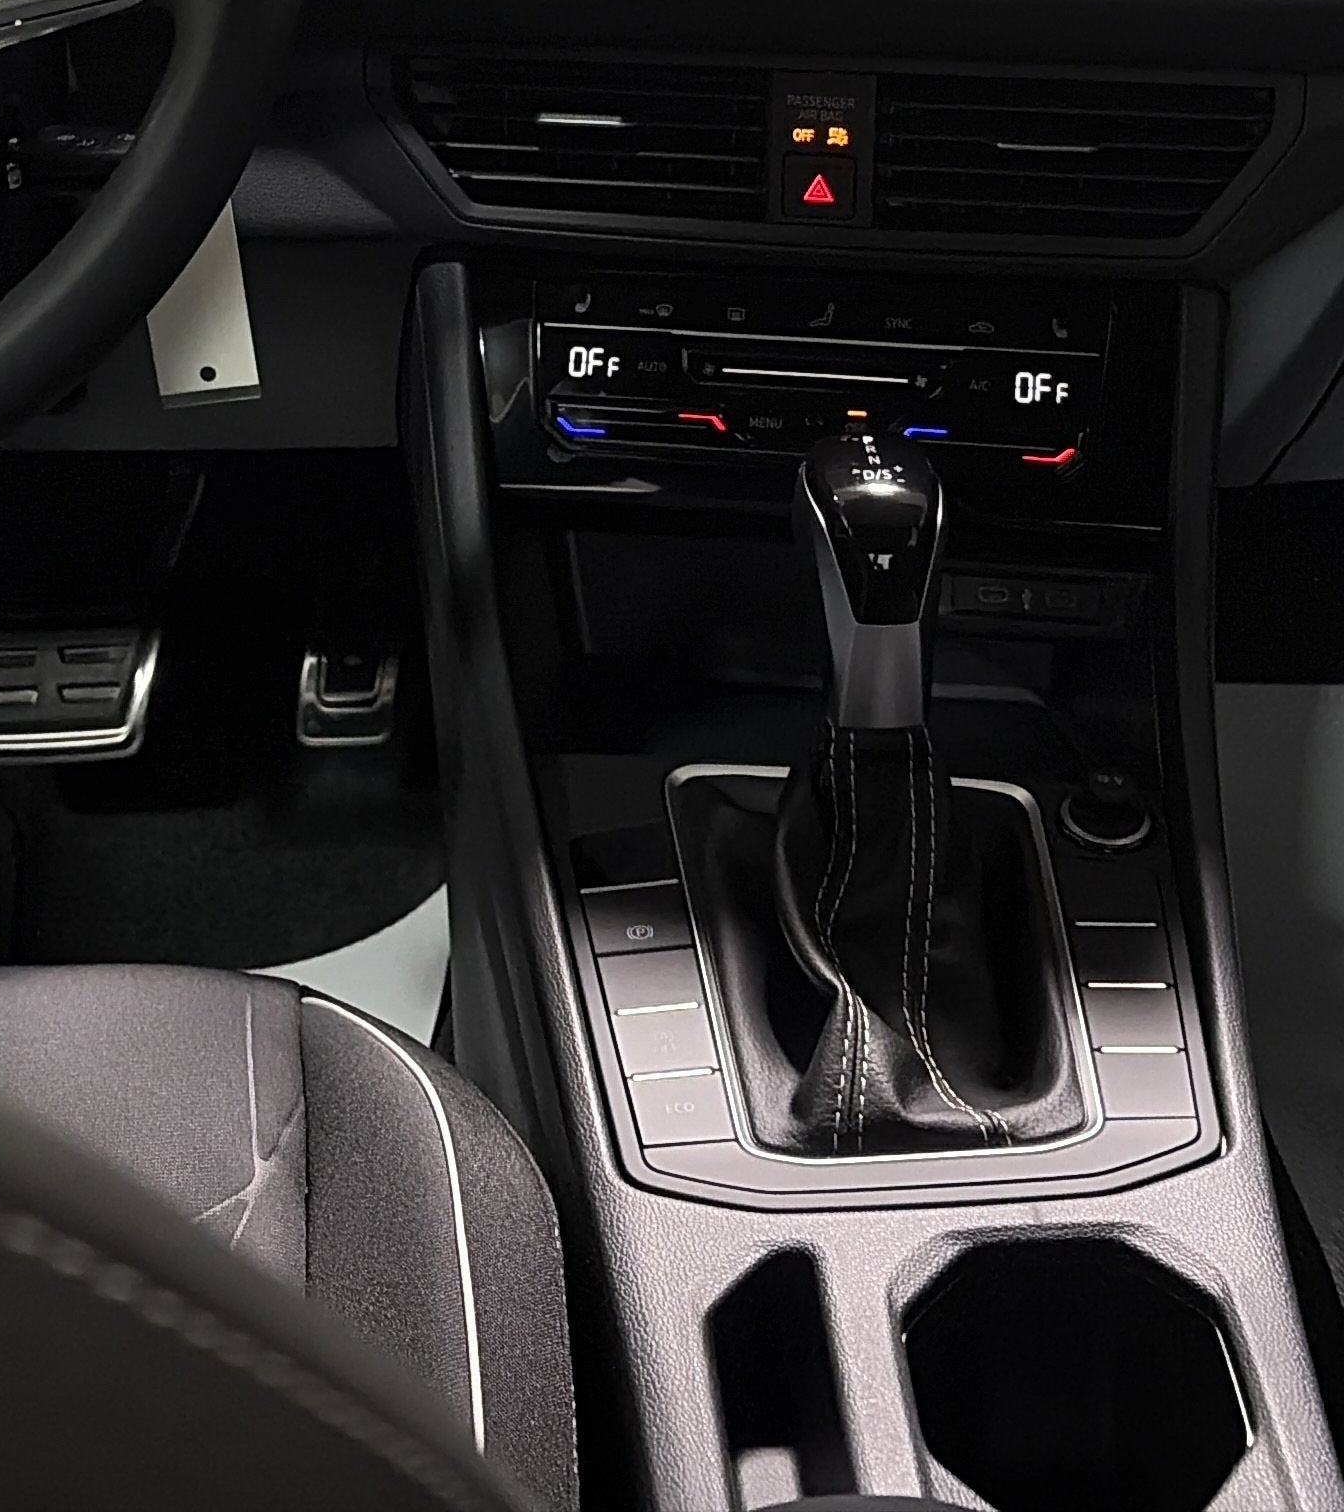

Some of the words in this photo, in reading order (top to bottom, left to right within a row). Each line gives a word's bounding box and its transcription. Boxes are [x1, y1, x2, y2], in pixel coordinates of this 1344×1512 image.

[786, 93, 856, 109] PASSENGER
[798, 108, 817, 120] AIR
[792, 127, 816, 142] OFF
[884, 316, 913, 330] SYNC
[748, 416, 783, 430] MENU
